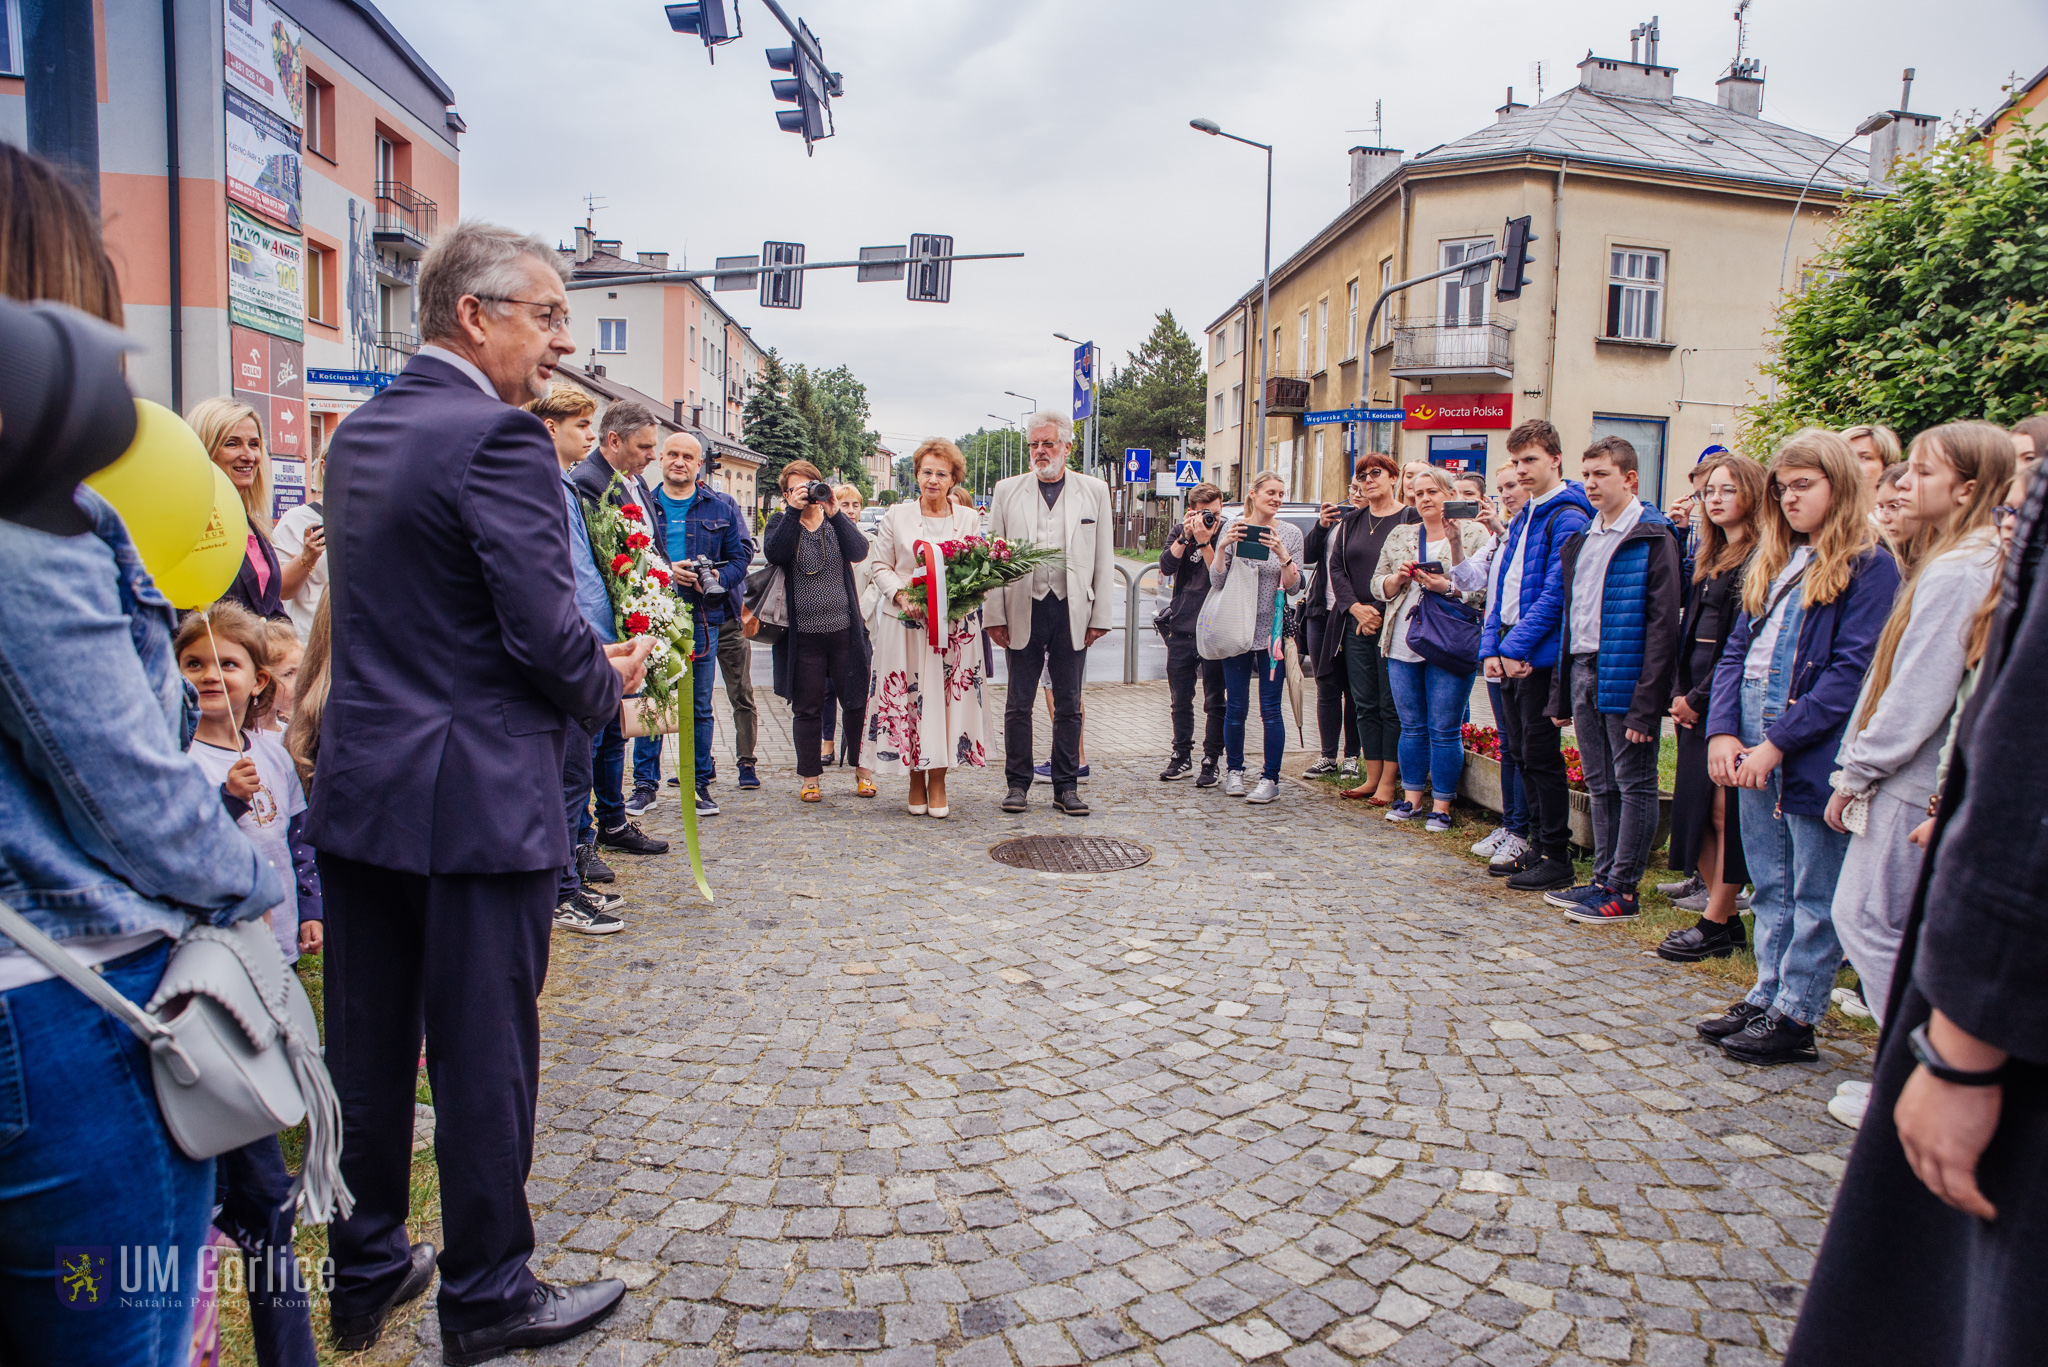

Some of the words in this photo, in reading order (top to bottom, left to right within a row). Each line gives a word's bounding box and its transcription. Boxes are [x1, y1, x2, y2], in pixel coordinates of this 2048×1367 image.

[229, 94, 242, 108] NOWE
[231, 220, 260, 246] TYLKO
[270, 240, 300, 264] ANMAR
[275, 261, 297, 293] 100
[243, 365, 261, 377] ORLEN
[319, 372, 359, 381] Kościuszki
[1371, 411, 1403, 419] Kościuszki
[1439, 407, 1471, 417] Poczta
[1472, 405, 1504, 417] Polska
[1306, 414, 1341, 424] Węgierska
[279, 431, 284, 443] 1
[284, 432, 298, 445] min
[282, 464, 295, 473] BIURO
[274, 473, 303, 484] RACHUNKOWE
